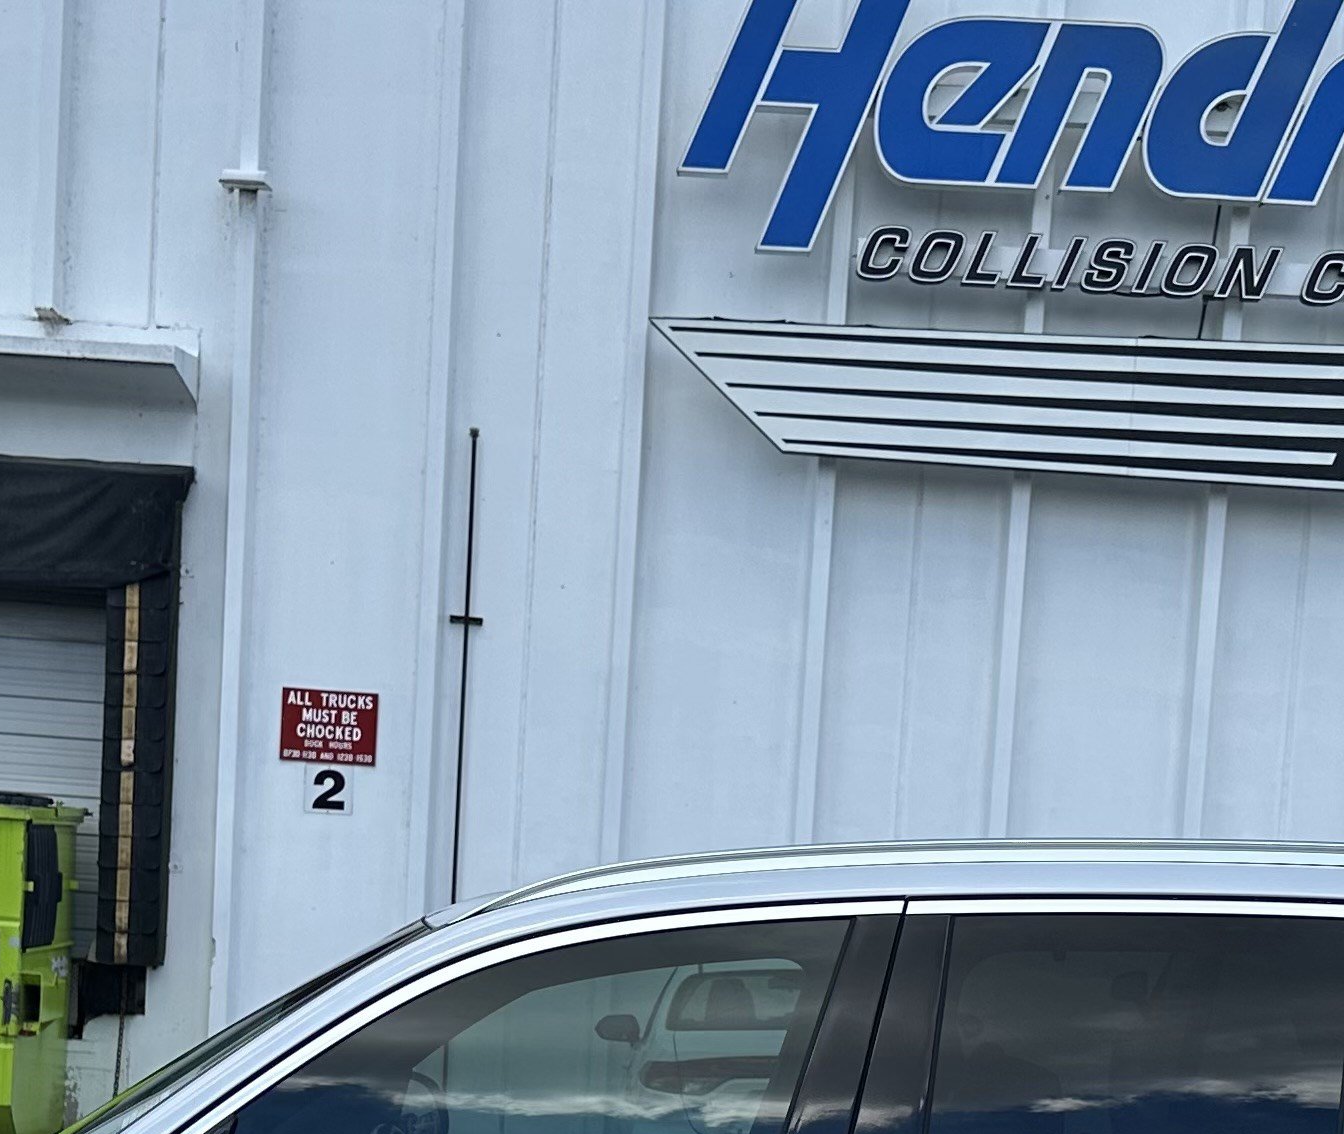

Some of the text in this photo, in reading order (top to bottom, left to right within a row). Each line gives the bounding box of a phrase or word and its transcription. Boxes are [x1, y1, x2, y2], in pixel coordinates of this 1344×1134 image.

[857, 225, 1288, 300] COLLISION
[287, 690, 374, 710] ALL TRUCKS
[302, 707, 358, 726] MUST BE
[296, 723, 362, 742] CHOCKED
[312, 769, 346, 811] 2
